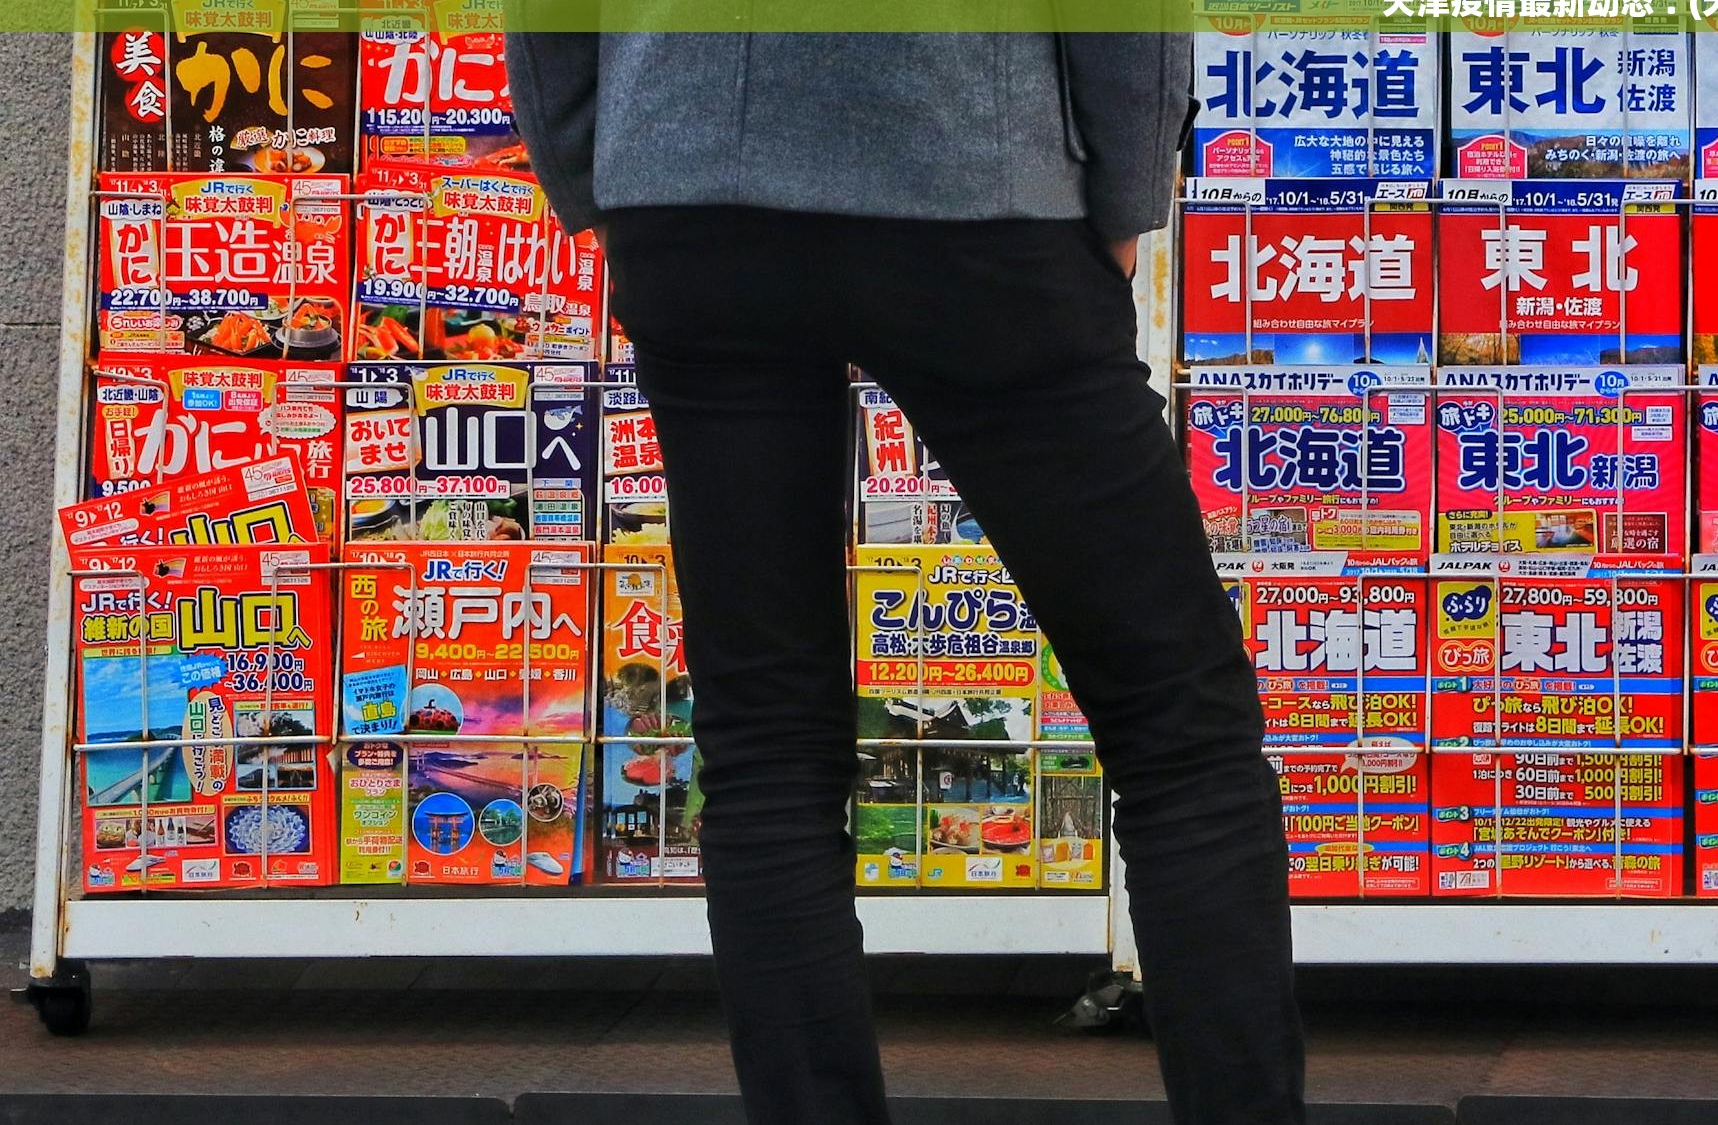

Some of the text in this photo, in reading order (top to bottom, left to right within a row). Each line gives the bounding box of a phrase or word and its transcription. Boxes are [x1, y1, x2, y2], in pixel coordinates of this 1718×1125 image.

[185, 11, 272, 28] 味覚太鼓判
[175, 42, 333, 122] かに
[1206, 47, 1420, 120] 北海道
[1461, 46, 1606, 116] 東北
[201, 179, 253, 193] JRで行く
[442, 176, 533, 196] スーパーはくとで行く
[107, 202, 162, 216] 山陰・しまね
[185, 196, 273, 214] 味覚太鼓判
[444, 191, 531, 213] 味覚太鼓判
[1210, 234, 1416, 303] 北海道
[1481, 226, 1639, 292] 東北
[1515, 297, 1602, 317] 新潟・佐渡
[1253, 318, 1374, 329] 組み合わせ自由な旅マイプラン
[183, 369, 264, 389] 味覚太鼓判
[354, 389, 391, 406] 山陽
[426, 383, 515, 403] 味覚太鼓判
[109, 418, 131, 475] 日帰り
[424, 405, 582, 471] 山口へ
[873, 410, 907, 473] 紀州
[1213, 425, 1407, 492] 北海道
[424, 560, 506, 582] JRで行く!
[1437, 561, 1492, 572] JALPAK
[392, 585, 582, 642] 瀬戸内へ
[83, 613, 172, 643] 維新の国
[1255, 610, 1418, 673] 北海道
[442, 865, 480, 877] 日本旅行
